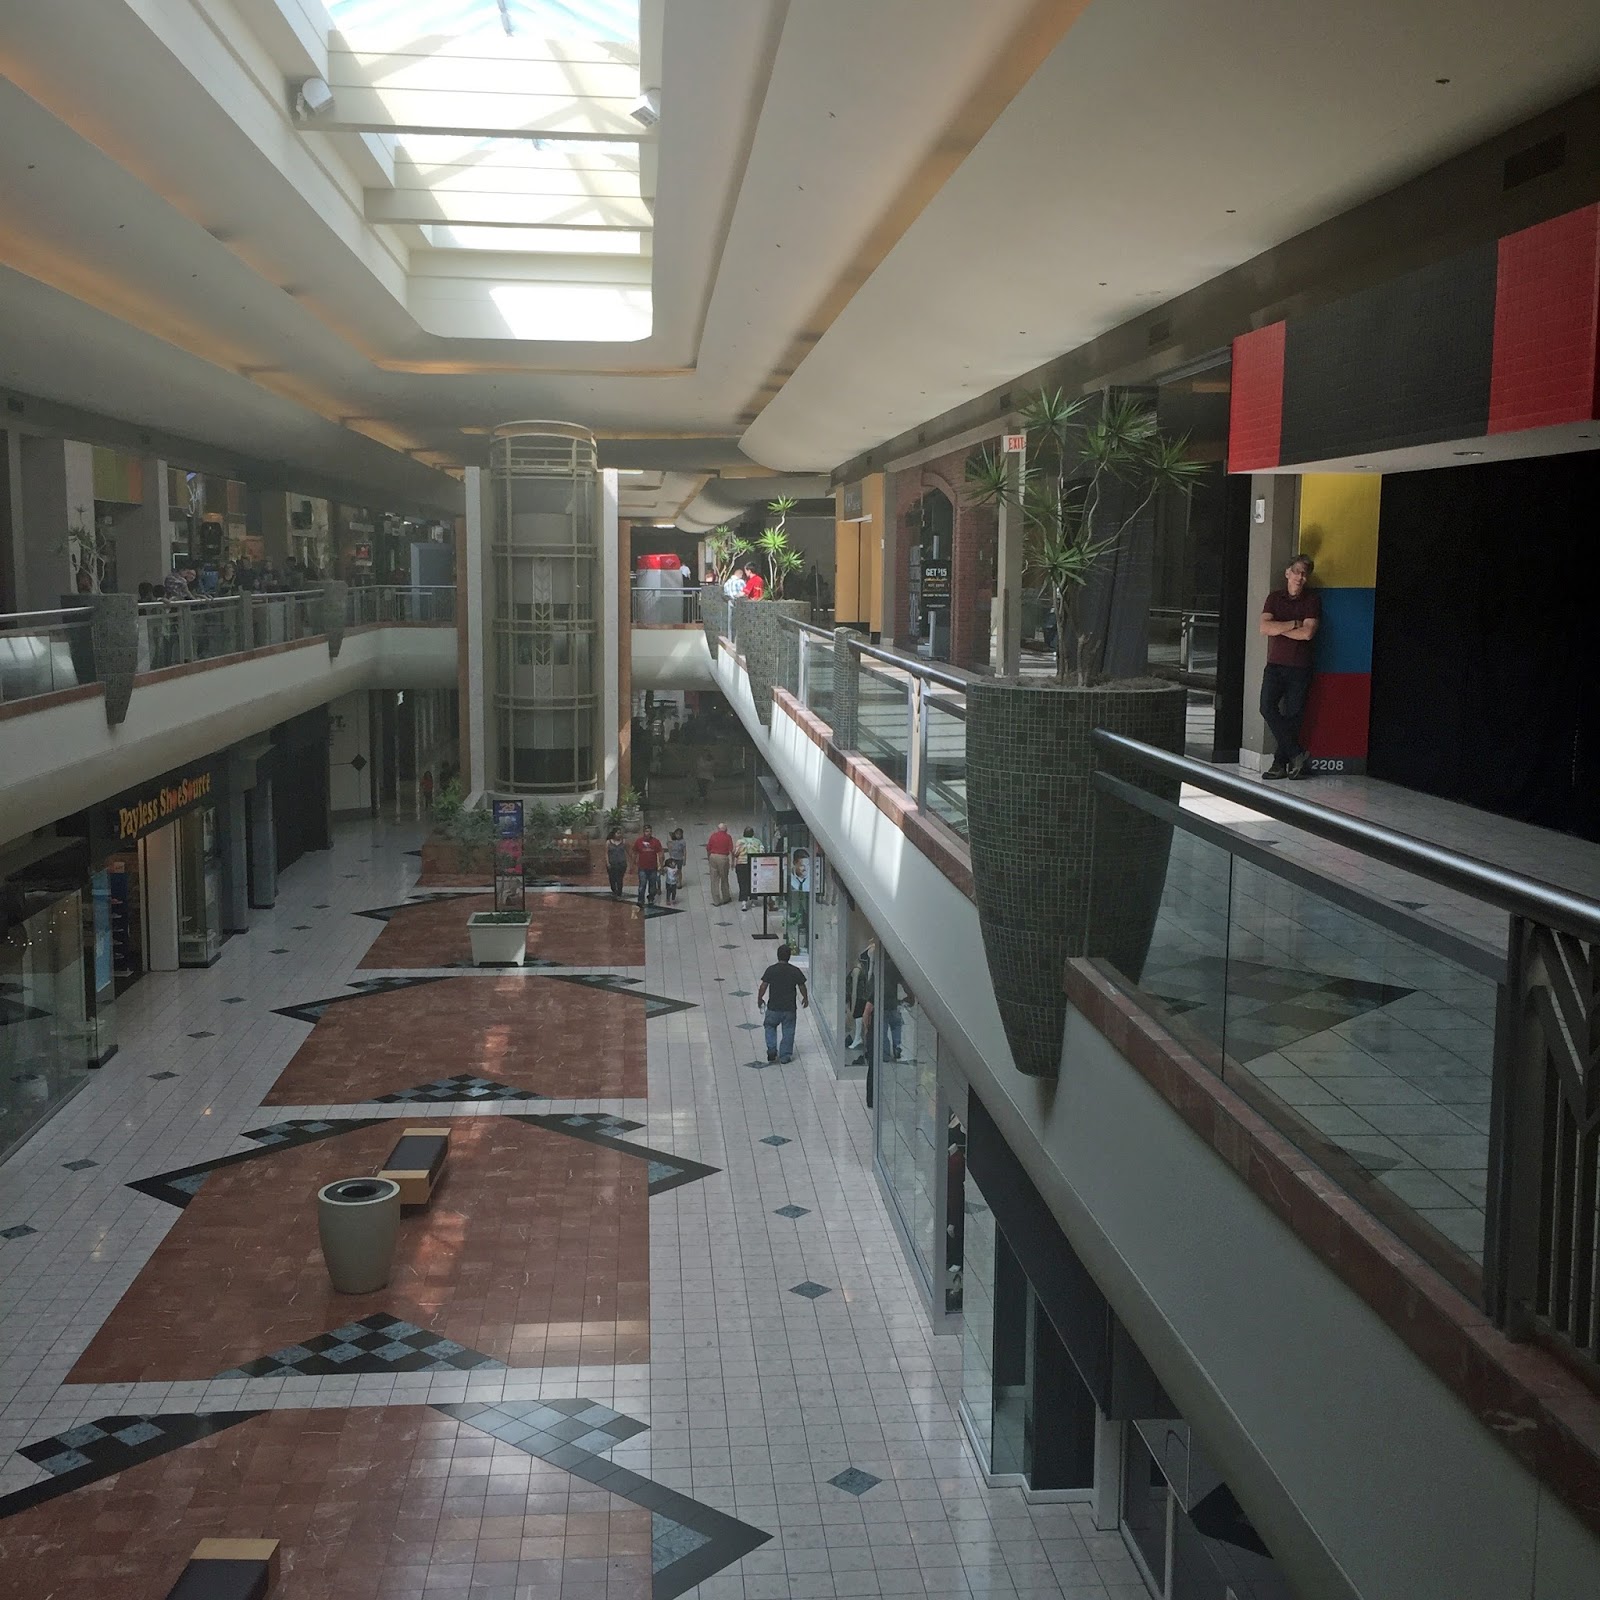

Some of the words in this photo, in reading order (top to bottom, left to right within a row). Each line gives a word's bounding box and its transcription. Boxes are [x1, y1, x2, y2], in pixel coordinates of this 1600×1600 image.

[1008, 437, 1024, 449] EXIT
[925, 568, 937, 576] GET
[1311, 759, 1344, 771] 2208
[119, 799, 158, 840] Payless
[160, 772, 211, 817] ShoeSource
